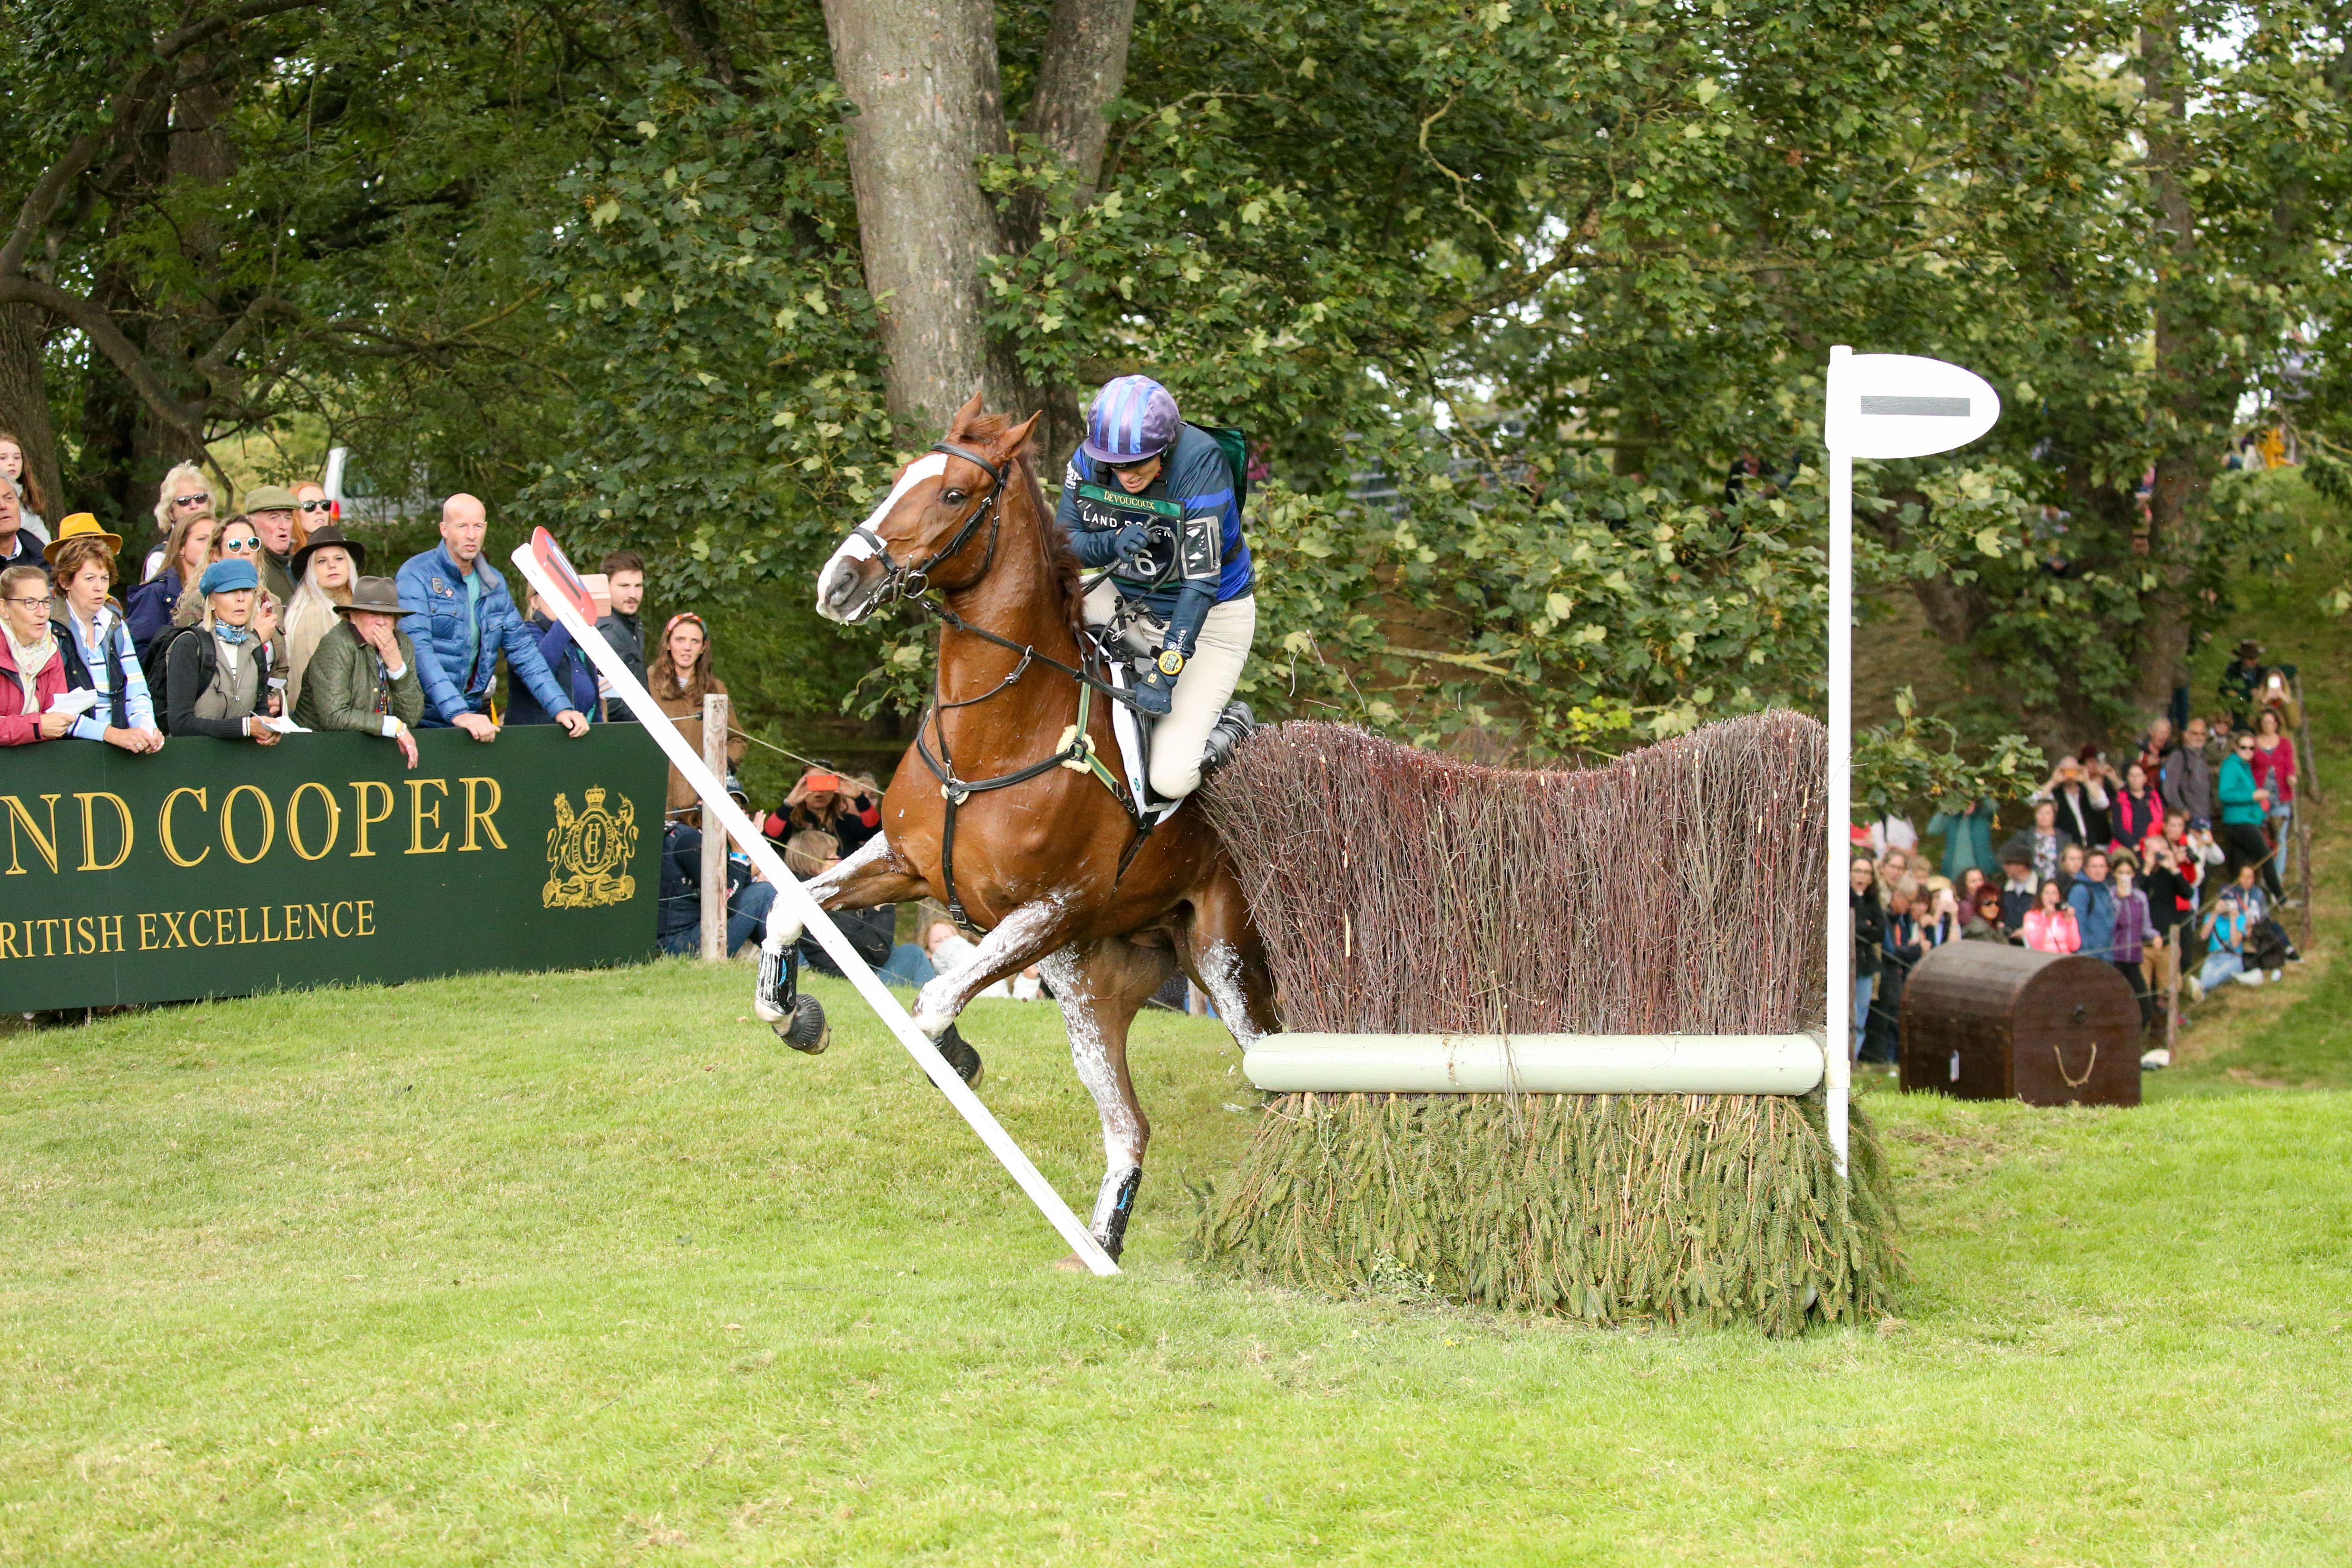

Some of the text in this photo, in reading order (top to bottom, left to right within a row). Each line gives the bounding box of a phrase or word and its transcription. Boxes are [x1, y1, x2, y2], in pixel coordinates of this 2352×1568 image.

[1103, 490, 1155, 510] DEVOUCOUX
[1083, 510, 1171, 538] LAND RER
[158, 777, 508, 867] COOPER
[137, 900, 376, 951] EXCELLENCE
